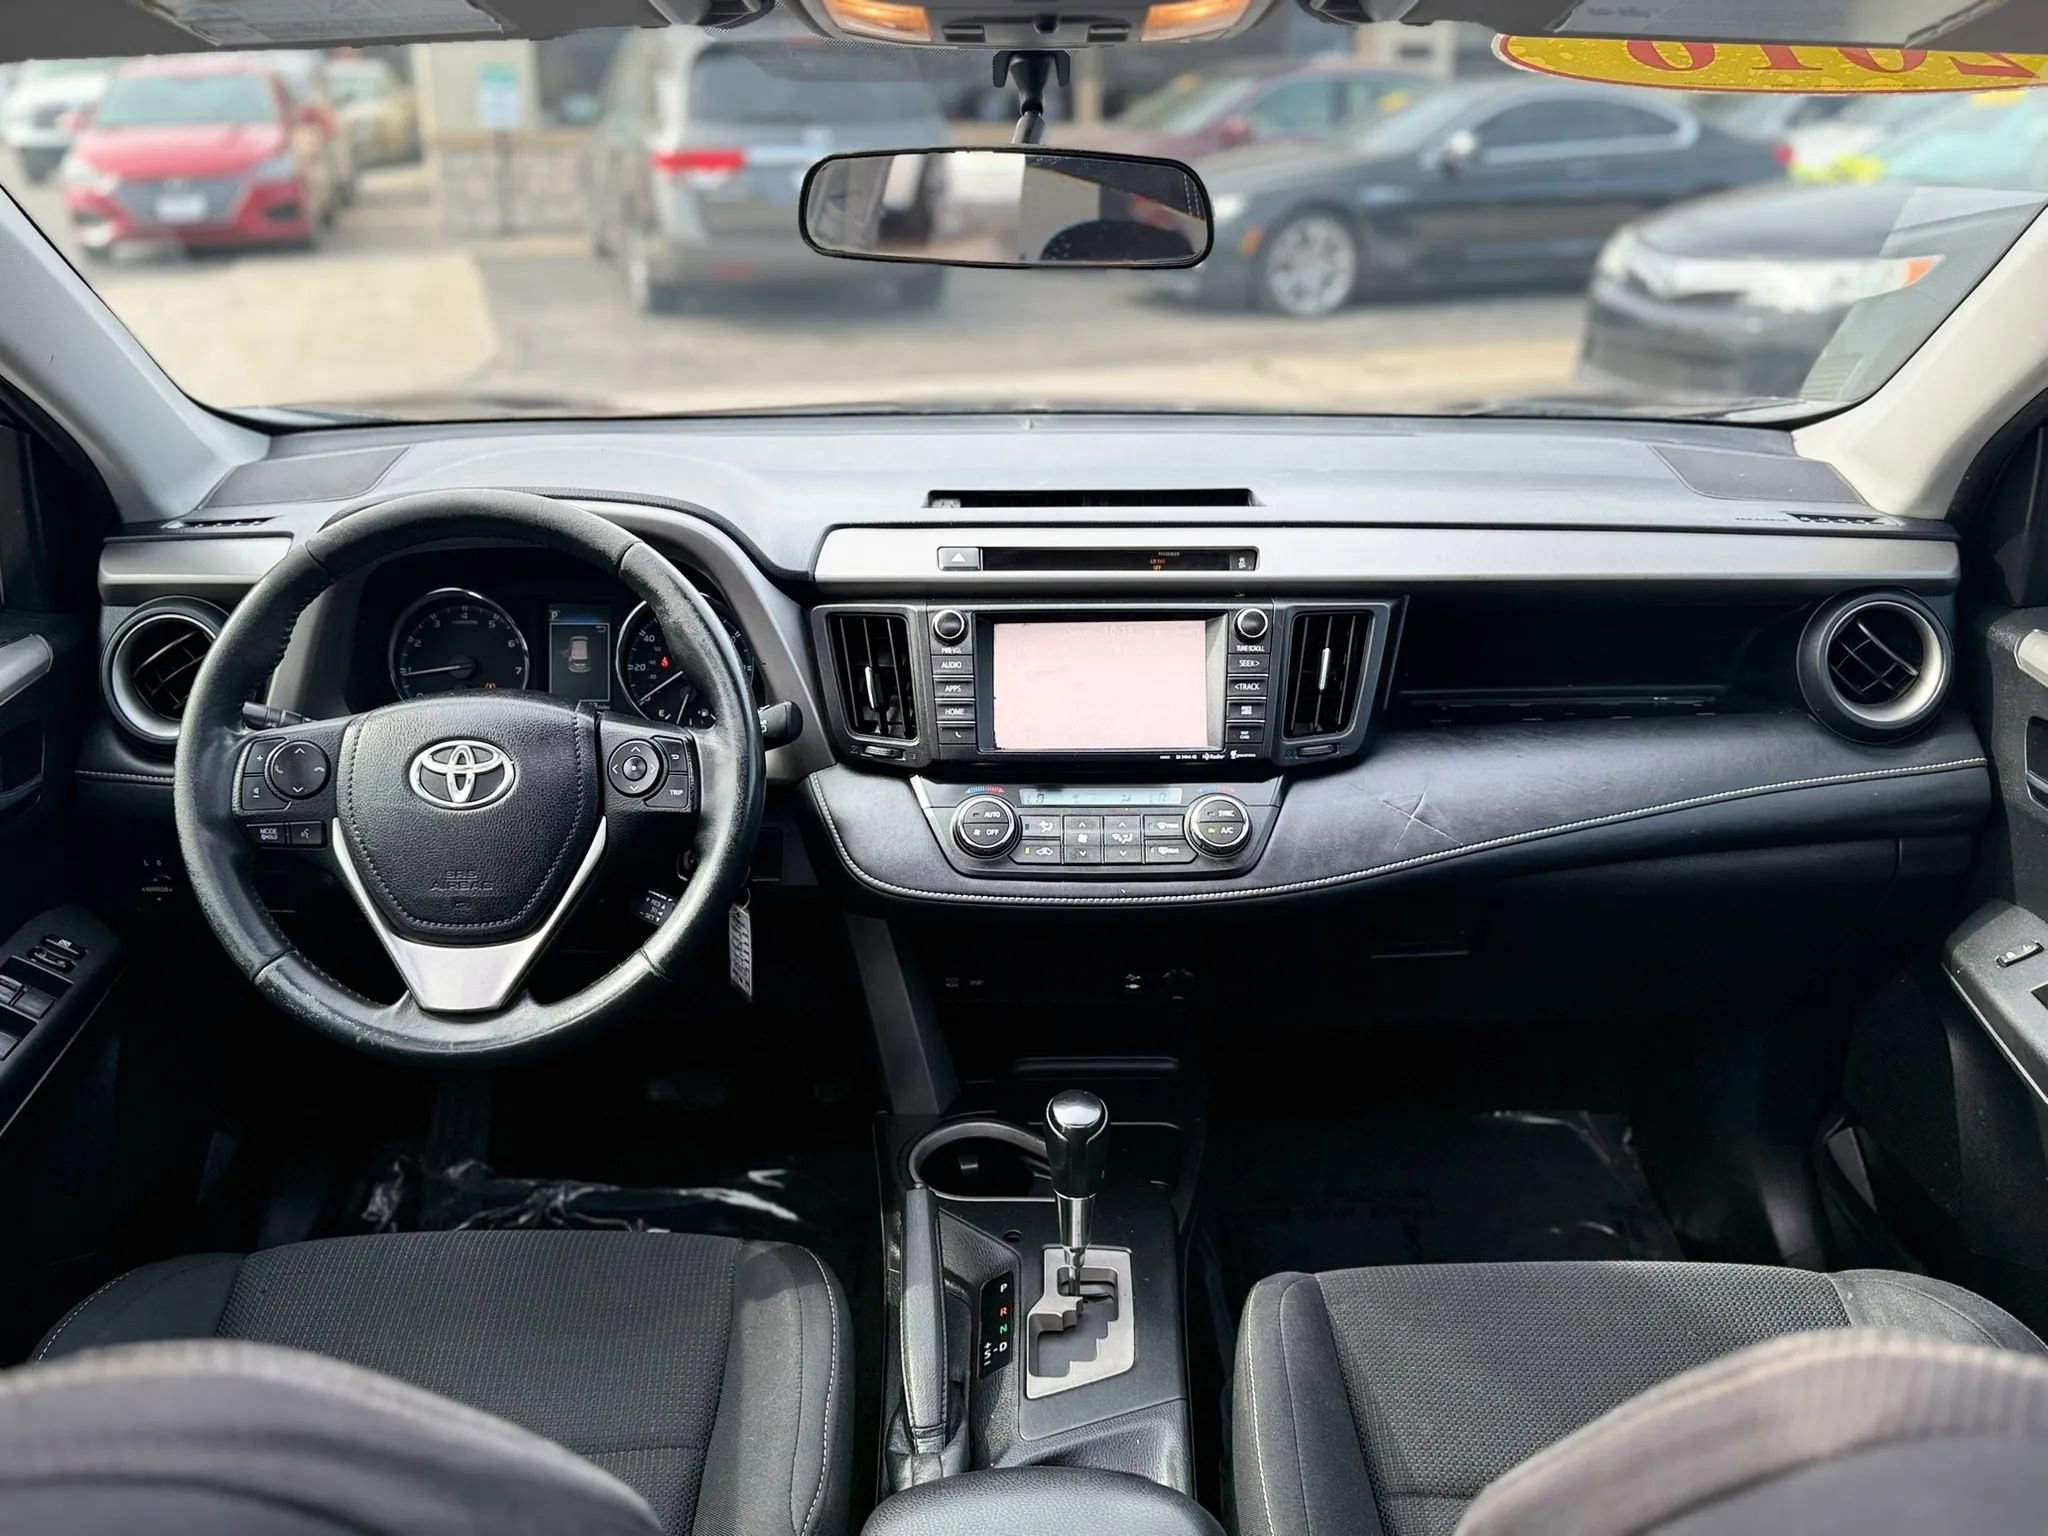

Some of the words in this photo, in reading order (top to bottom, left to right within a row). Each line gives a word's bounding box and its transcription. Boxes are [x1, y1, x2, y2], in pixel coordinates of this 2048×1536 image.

[488, 620, 496, 628] 5
[643, 634, 656, 642] 40
[414, 639, 422, 647] 2
[508, 640, 515, 648] 6
[634, 663, 647, 672] 20
[941, 661, 962, 669] AUDIO
[514, 666, 522, 675] 7
[944, 685, 962, 693] APPS
[945, 708, 965, 716] HOME
[445, 870, 478, 879] SRS
[430, 881, 494, 891] AIRBAG
[1000, 1283, 1008, 1293] P
[1000, 1306, 1008, 1317] R
[1000, 1323, 1008, 1334] N
[999, 1341, 1008, 1352] D
[983, 1349, 992, 1360] S
